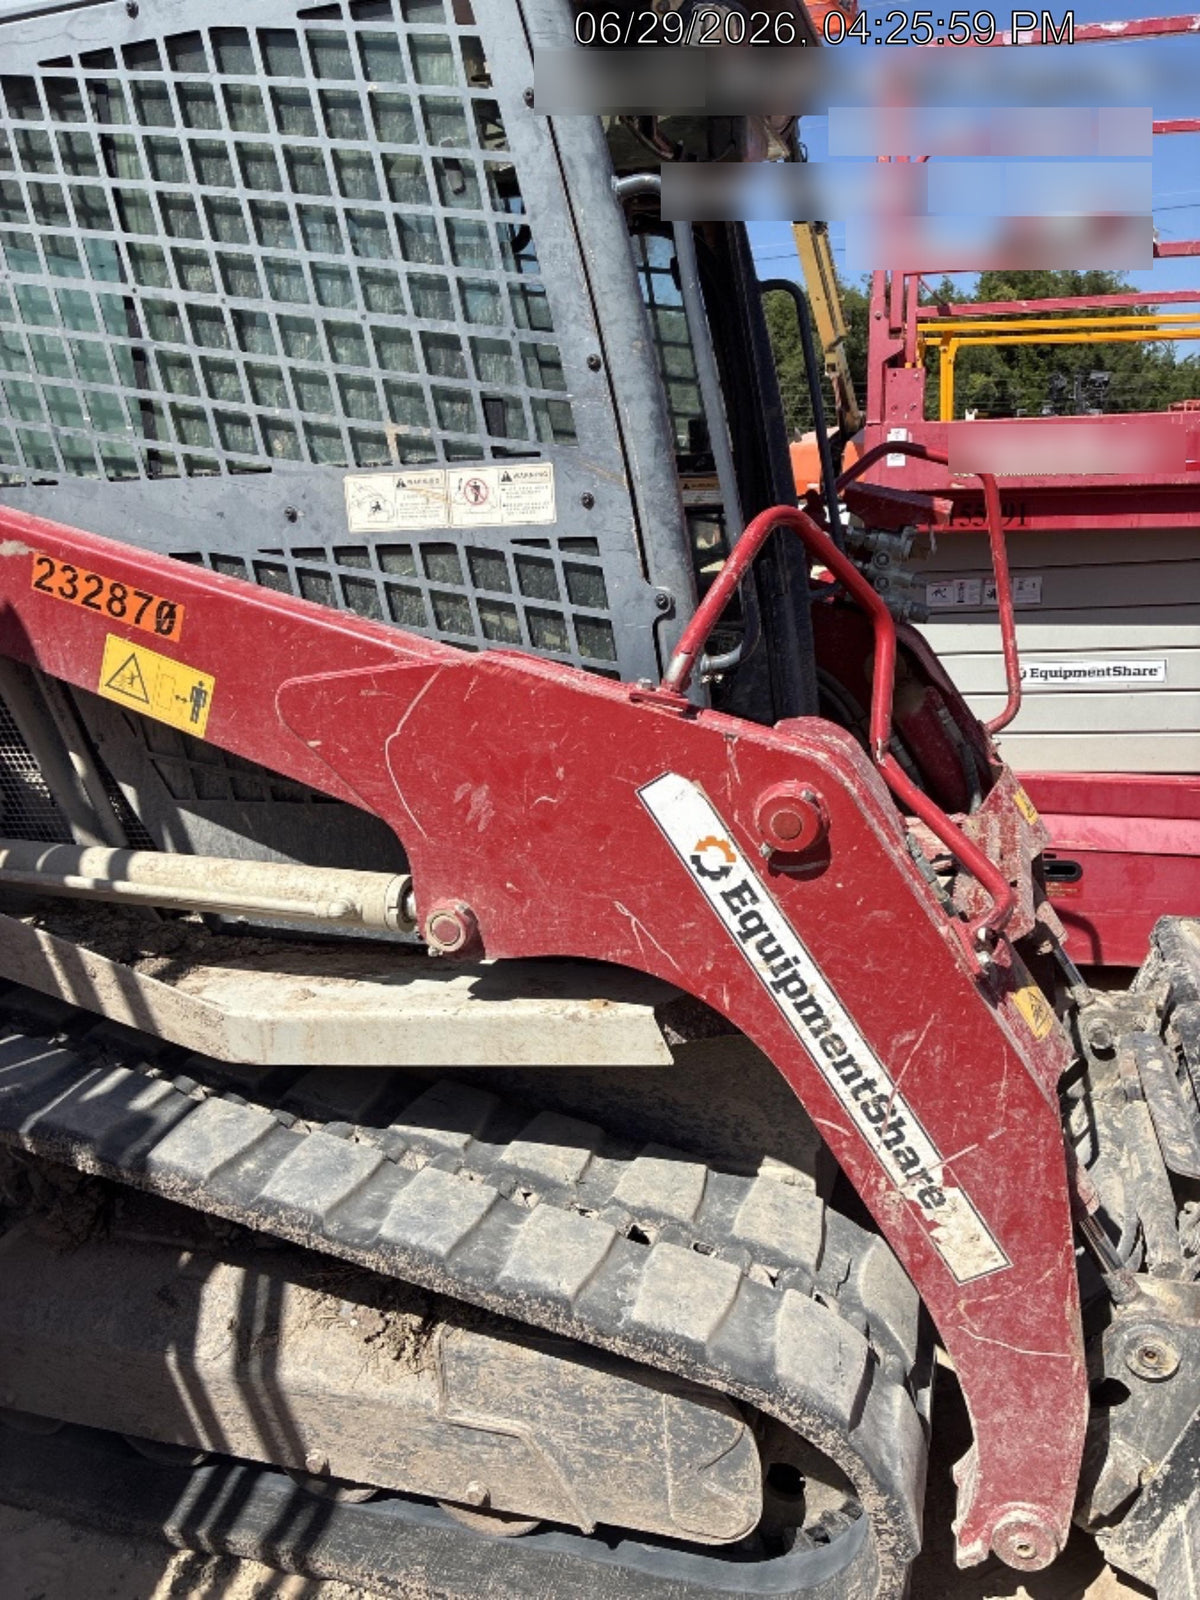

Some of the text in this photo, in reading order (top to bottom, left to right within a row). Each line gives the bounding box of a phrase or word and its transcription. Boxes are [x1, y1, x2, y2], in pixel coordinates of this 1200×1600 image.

[949, 499, 1028, 527] 15591
[33, 557, 178, 636] 232870
[1029, 665, 1159, 681] EquipmentShare
[719, 879, 947, 1210] EquipmentShare
